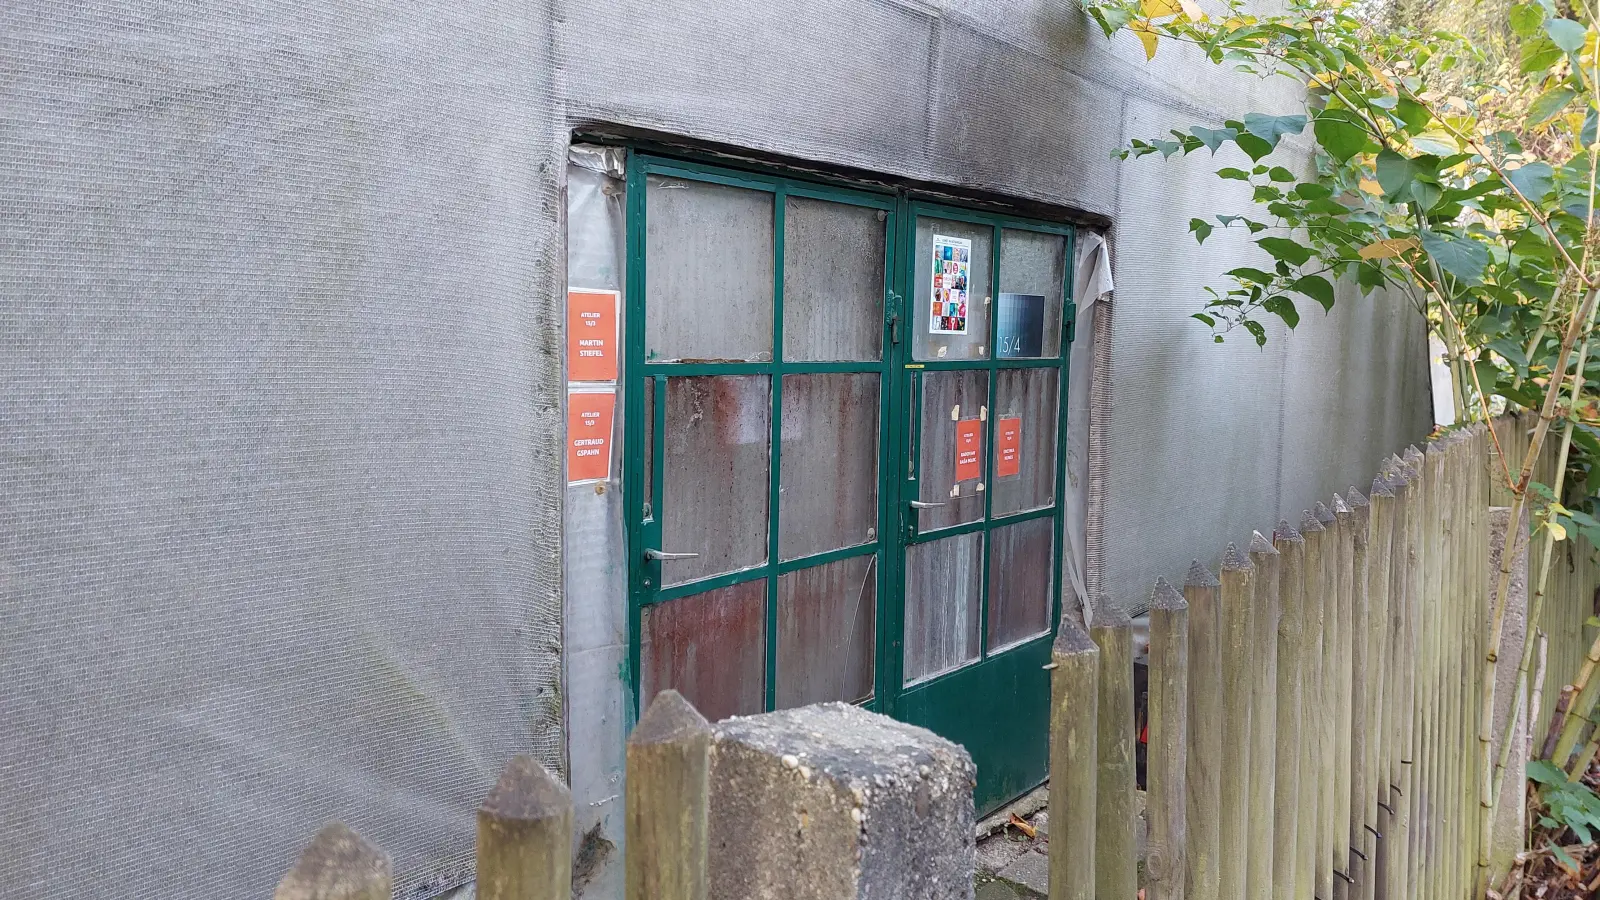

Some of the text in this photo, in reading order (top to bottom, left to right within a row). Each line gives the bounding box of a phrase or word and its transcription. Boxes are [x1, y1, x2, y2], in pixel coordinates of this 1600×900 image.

[579, 339, 604, 347] MARTIN
[999, 336, 1021, 355] 15/4
[573, 438, 604, 447] GERTRAUD
[576, 448, 600, 457] GSPAHN
